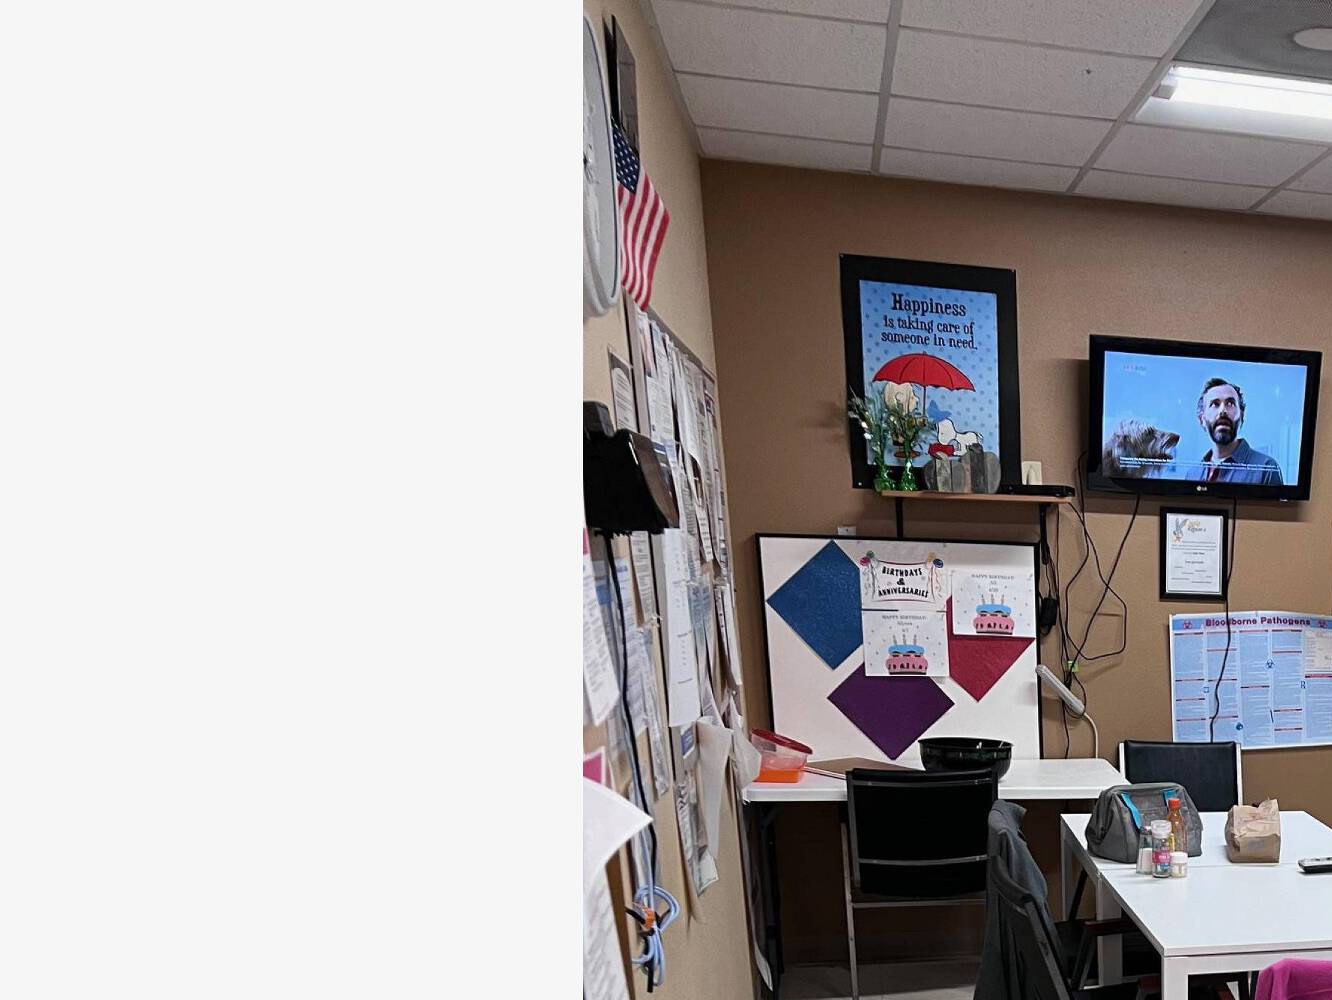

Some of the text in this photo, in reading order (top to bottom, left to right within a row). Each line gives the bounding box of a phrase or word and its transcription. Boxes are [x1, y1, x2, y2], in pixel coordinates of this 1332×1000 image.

[891, 292, 967, 316] Happiness
[883, 314, 975, 335] is taking care of
[881, 332, 978, 350] someone in need.
[882, 566, 923, 577] BIRTHDAYS
[897, 577, 905, 586] &
[878, 587, 929, 599] ANNIVERSARIES
[1260, 617, 1311, 626] Pathogens
